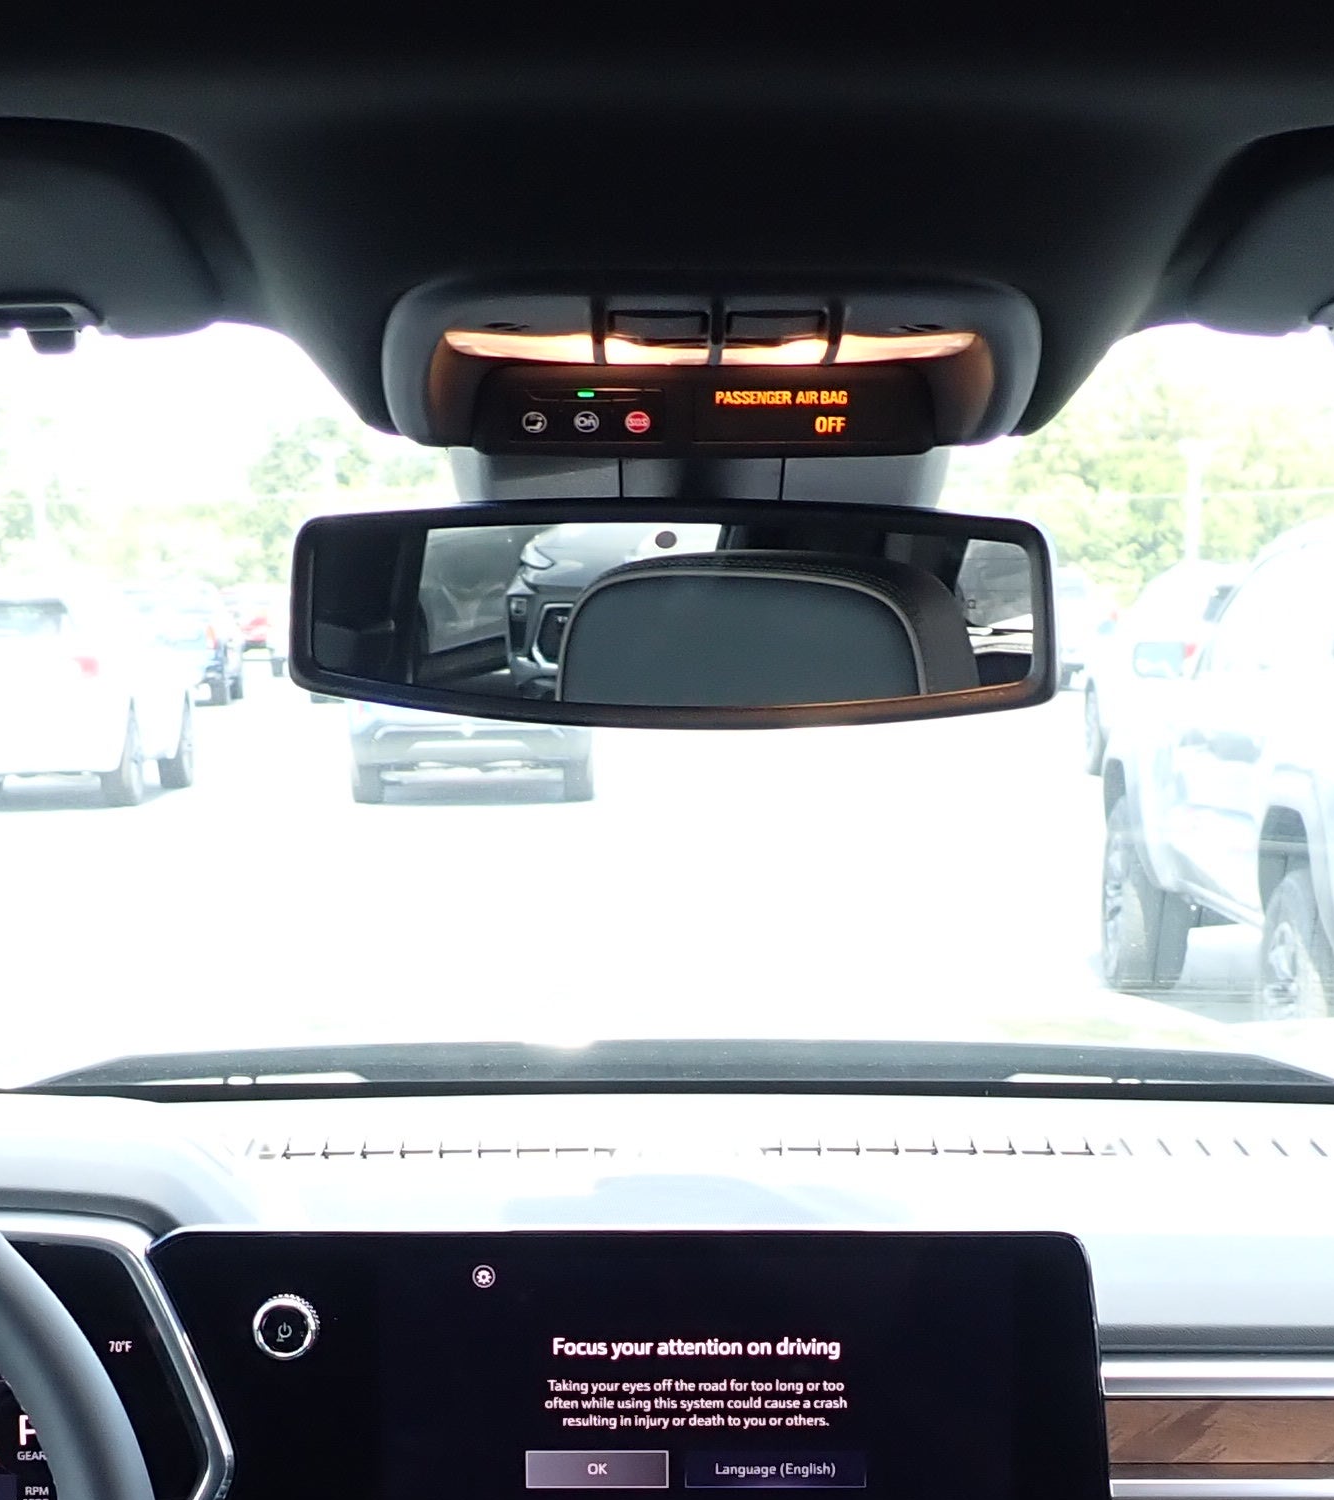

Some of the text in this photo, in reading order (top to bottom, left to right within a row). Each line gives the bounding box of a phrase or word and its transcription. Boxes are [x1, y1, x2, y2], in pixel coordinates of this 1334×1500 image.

[715, 391, 792, 405] PASSENGER
[815, 416, 846, 434] OFF
[553, 1338, 841, 1360] Focus your attention on driving
[547, 1380, 844, 1394] Taking your eyes off the road for too long or too
[545, 1397, 847, 1412] often while using this system could cause a crash
[563, 1415, 830, 1429] resulting in injury or death to you or others.
[17, 1451, 46, 1461] GEAR
[588, 1463, 608, 1476] OK
[715, 1462, 837, 1479] Language (English)
[25, 1486, 50, 1496] RPM
